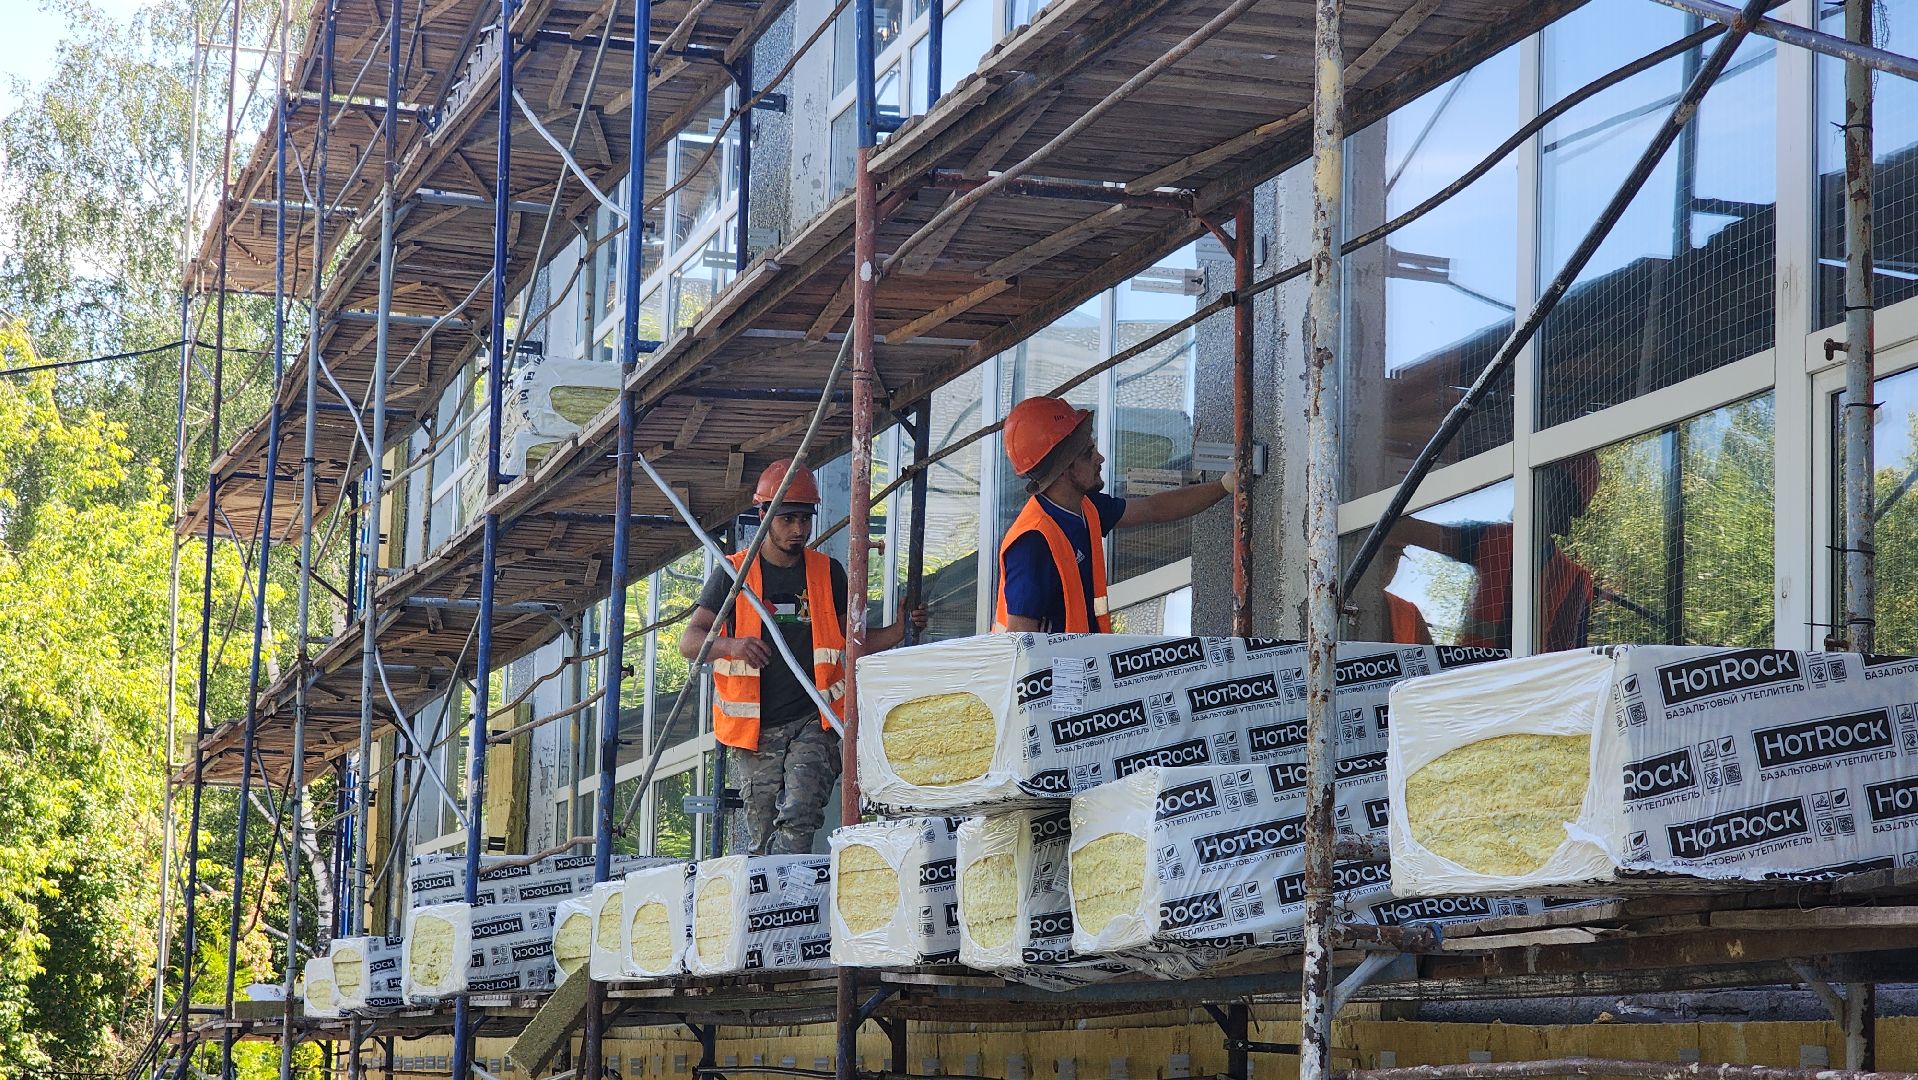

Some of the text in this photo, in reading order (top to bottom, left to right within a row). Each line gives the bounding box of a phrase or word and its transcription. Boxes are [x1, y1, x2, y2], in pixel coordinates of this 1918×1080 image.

[1115, 642, 1201, 674] HOTROCK
[1247, 648, 1293, 661] БАЗАЛЬТОВЫЙ
[1114, 663, 1208, 689] БАЗАЛЬТОВЫЙ УТЕПЛИТЕЛЬ
[1667, 652, 1794, 697] HOTROCK
[1194, 679, 1274, 708] HOTROCK
[1665, 683, 1805, 720] БАЗАЛЬТОВЫЙ УТЕПЛИТЕЛЬ
[1057, 708, 1143, 740] HOTROCK
[1191, 700, 1282, 723] БАЗАЛЬТОВЫЙ УТЕПЛИТЕЛЬ
[1055, 727, 1150, 753] БАЗАЛЬТОВЫЙ УТЕПЛИТЕЛЬ
[1763, 719, 1887, 760] HOTROCK
[1251, 749, 1297, 762] БАЗАЛЬТОВЫЙ
[1760, 750, 1897, 782] БАЗАЛЬТОВЫЙ УТЕПЛИТЕЛЬ
[1624, 759, 1690, 794] ROCK
[1156, 786, 1213, 815] ROCK
[1637, 791, 1700, 811] УТЕПЛИТЕЛЬ
[1165, 809, 1222, 829] УТЕПЛИТЕЛЬ
[1677, 807, 1802, 853] HOTROCK
[1202, 822, 1307, 858] HOTROCK
[1749, 836, 1812, 859] УТЕПЛИТЕЛЬ
[1201, 856, 1265, 875] БАЗАЛЬТОВЫЙ
[522, 884, 569, 898] HOTROCK
[1160, 899, 1219, 926] ROCK
[1379, 897, 1486, 924] HOTROCK
[1171, 922, 1228, 940] УТЕПЛИТЕЛЬ
